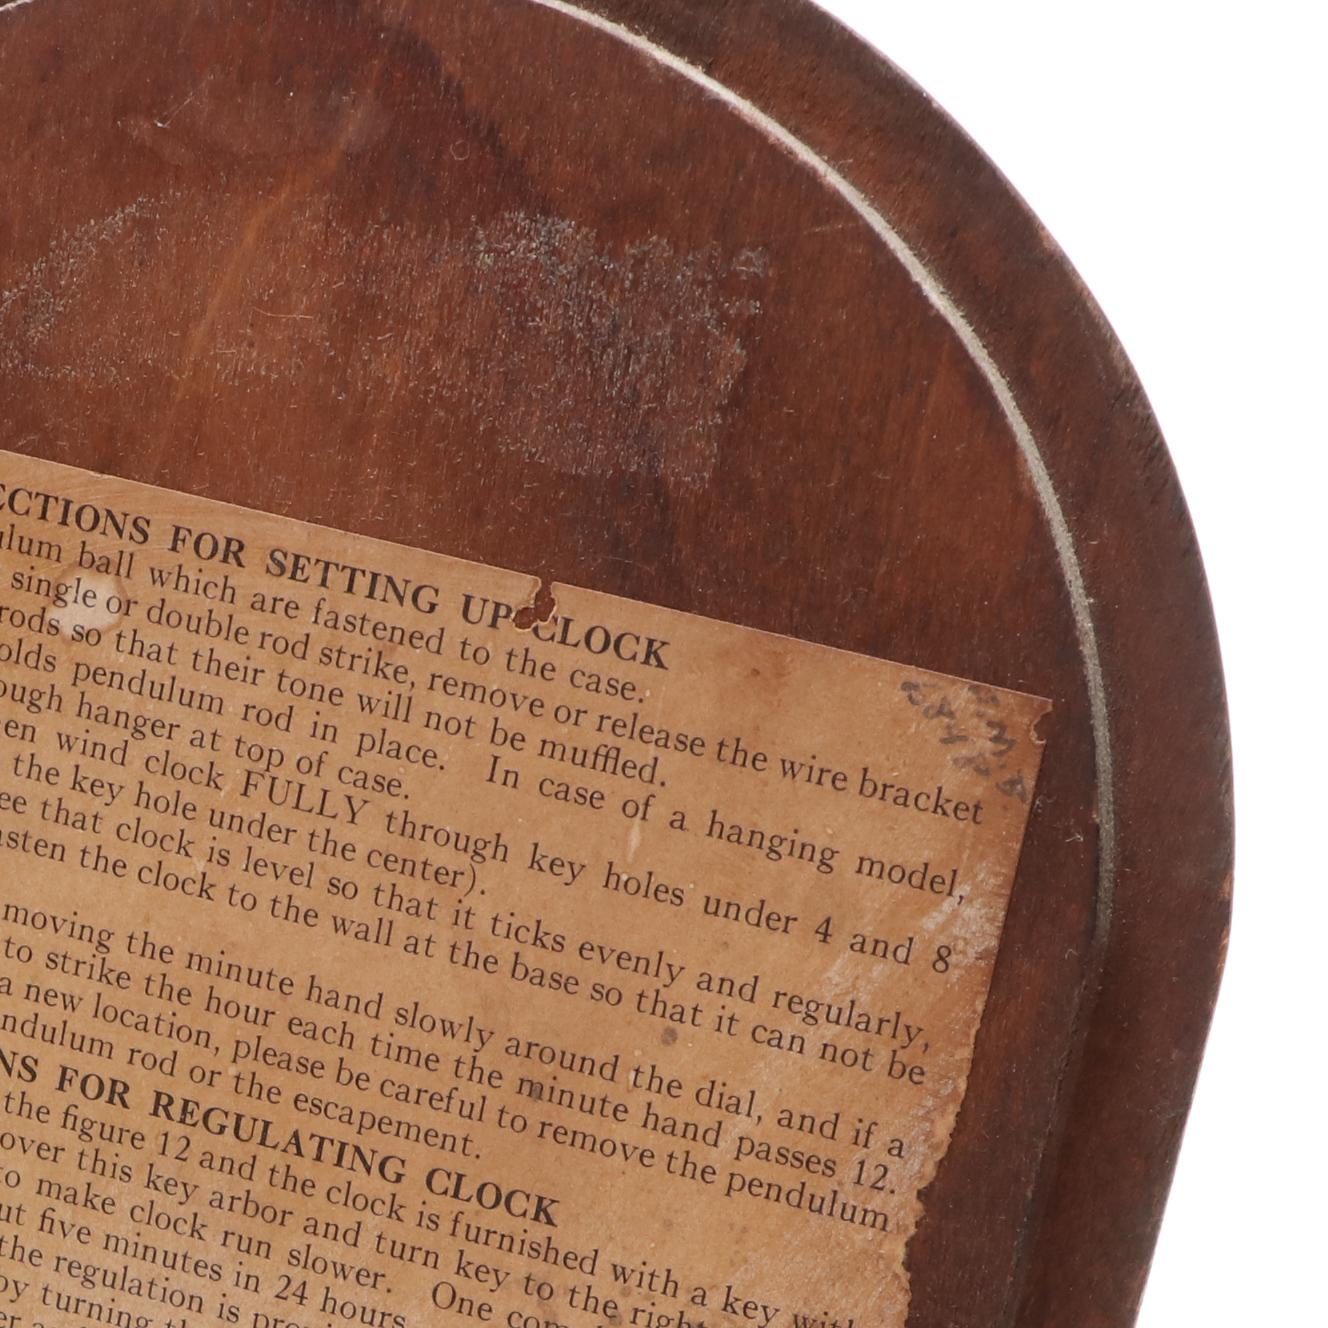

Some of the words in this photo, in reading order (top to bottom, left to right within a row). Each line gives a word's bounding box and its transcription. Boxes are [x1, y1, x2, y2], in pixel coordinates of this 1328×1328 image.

[166, 524, 246, 569] FOR
[264, 547, 440, 615] SETTING
[461, 592, 513, 631] UP
[531, 616, 670, 671] CLOCK
[70, 623, 102, 647] so
[115, 628, 178, 666] that
[191, 647, 266, 687] their
[276, 668, 344, 707] tone
[357, 689, 413, 724] will
[423, 710, 476, 740] not
[489, 716, 527, 752] be
[536, 738, 666, 788] muffled.
[54, 1063, 131, 1111] FOR
[147, 1089, 407, 1185] REGULATING
[424, 1167, 561, 1229] CLOCK
[126, 1047, 178, 1078] rod
[188, 1064, 223, 1088] or
[233, 1070, 282, 1105] the
[292, 1092, 481, 1160] escapement.
[36, 1206, 92, 1246] five
[101, 1231, 223, 1283] minutes
[233, 1260, 260, 1295] in
[273, 1273, 309, 1307] 24
